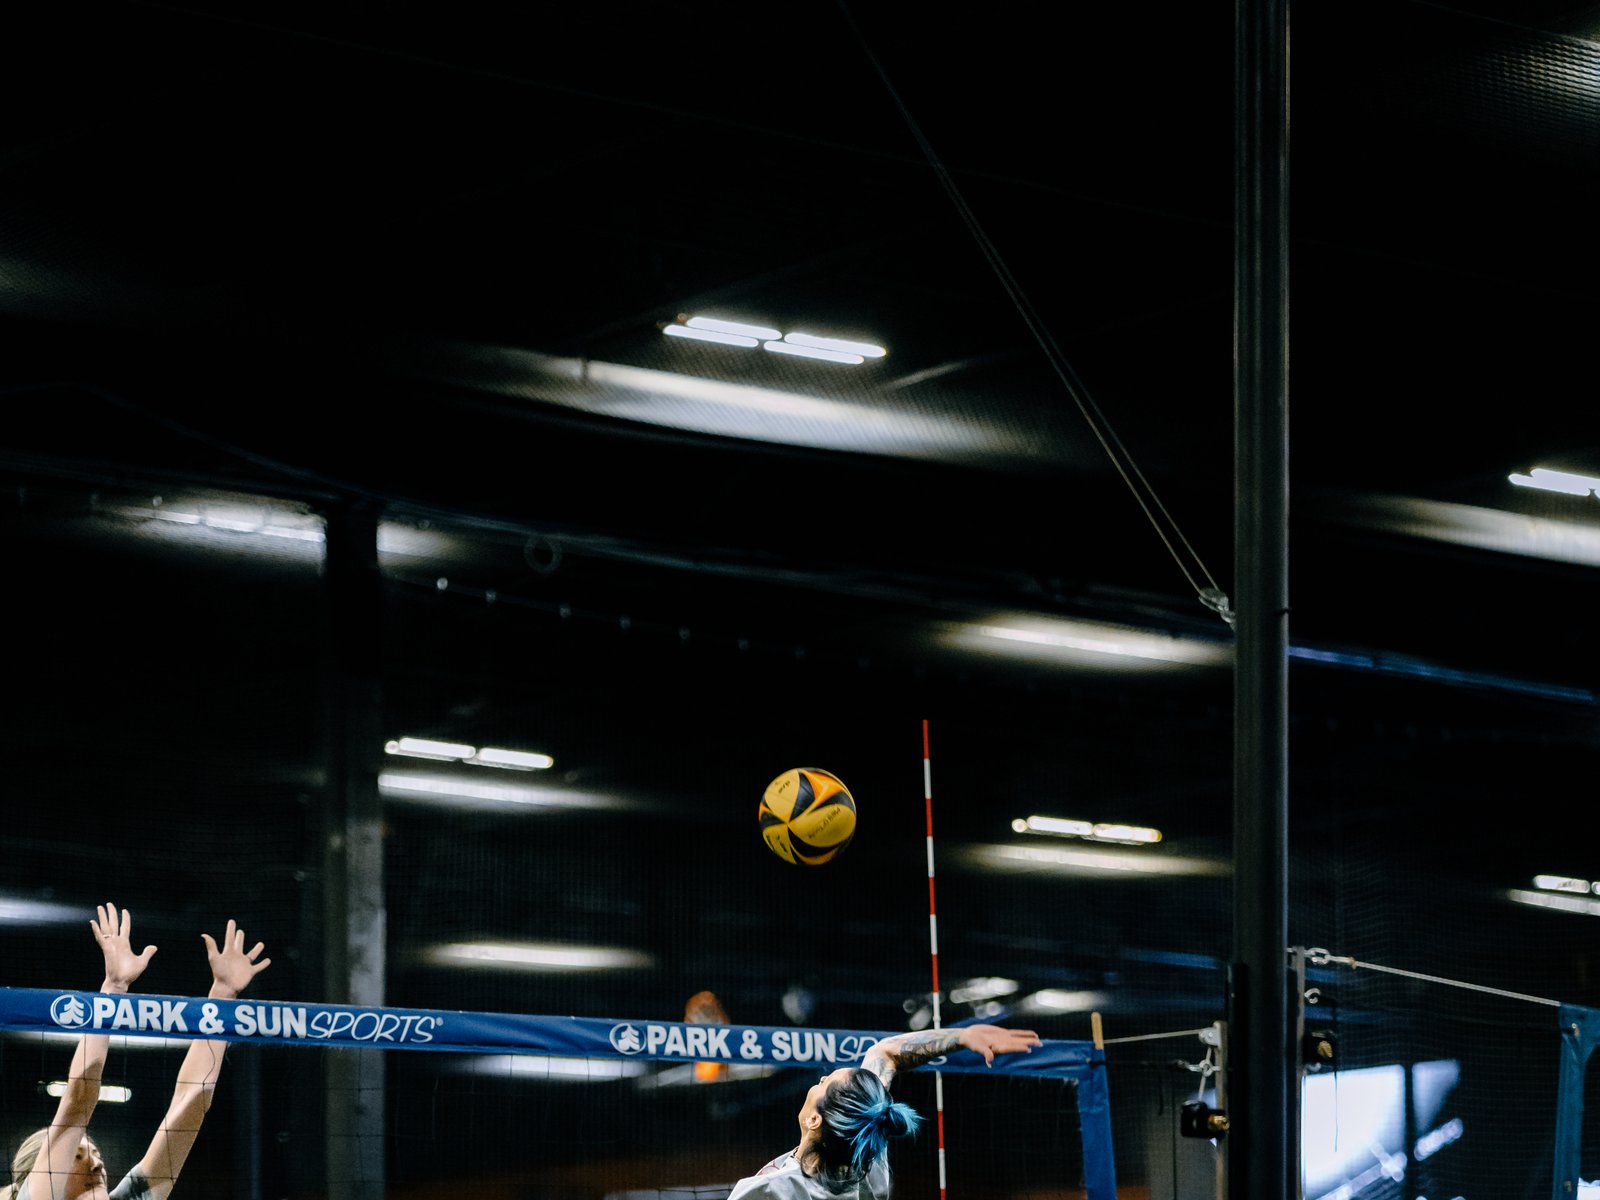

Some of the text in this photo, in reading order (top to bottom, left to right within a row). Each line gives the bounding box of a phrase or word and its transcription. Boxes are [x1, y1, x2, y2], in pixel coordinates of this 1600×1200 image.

[92, 996, 189, 1034] PARK
[199, 1002, 226, 1035] &
[646, 1025, 733, 1059] PARK
[740, 1029, 764, 1060] &
